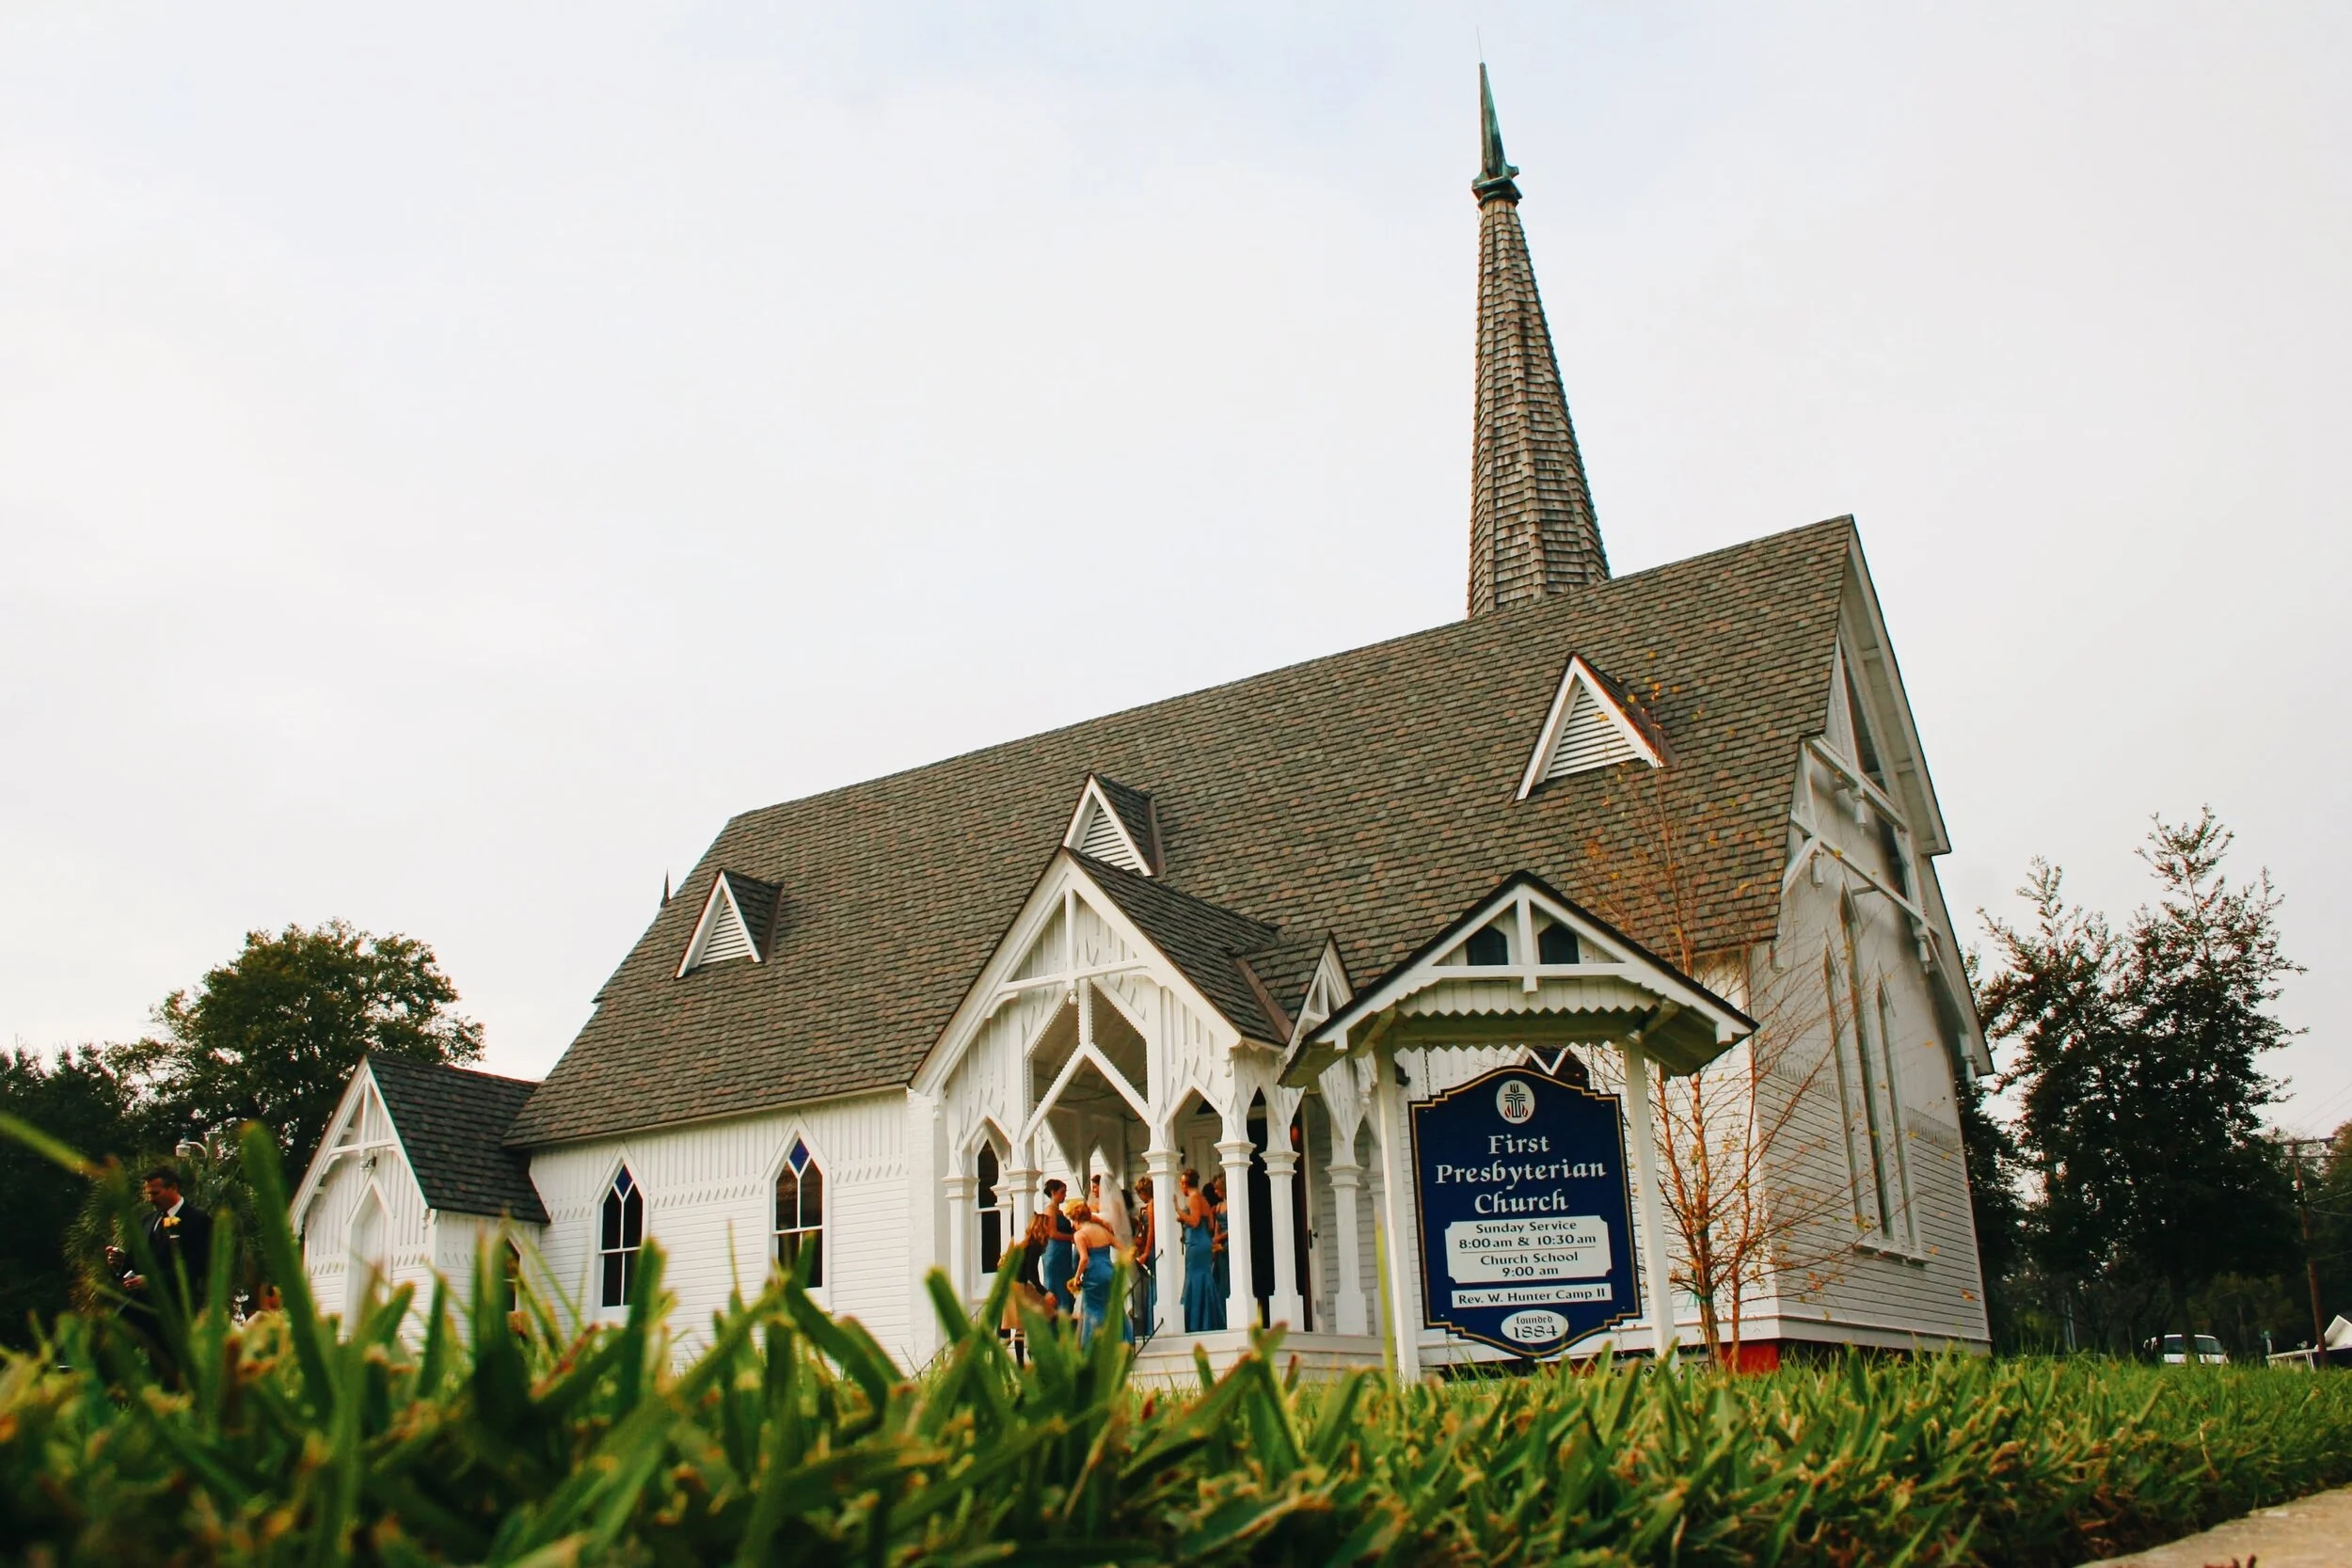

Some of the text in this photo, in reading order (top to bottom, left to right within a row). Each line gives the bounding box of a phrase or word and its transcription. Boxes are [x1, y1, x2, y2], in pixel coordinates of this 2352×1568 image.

[1488, 1133, 1550, 1154] First
[1436, 1159, 1607, 1190] Presbyterian
[1474, 1189, 1568, 1213] Church
[1476, 1220, 1577, 1234] Sunday Service
[1518, 1236, 1530, 1246] &
[1480, 1252, 1578, 1265] Church School
[1502, 1266, 1558, 1276] 9:00 am
[1458, 1288, 1605, 1305] Rev. W. Hunter Camp II
[1516, 1315, 1552, 1324] founded
[1514, 1325, 1558, 1338] 1884
